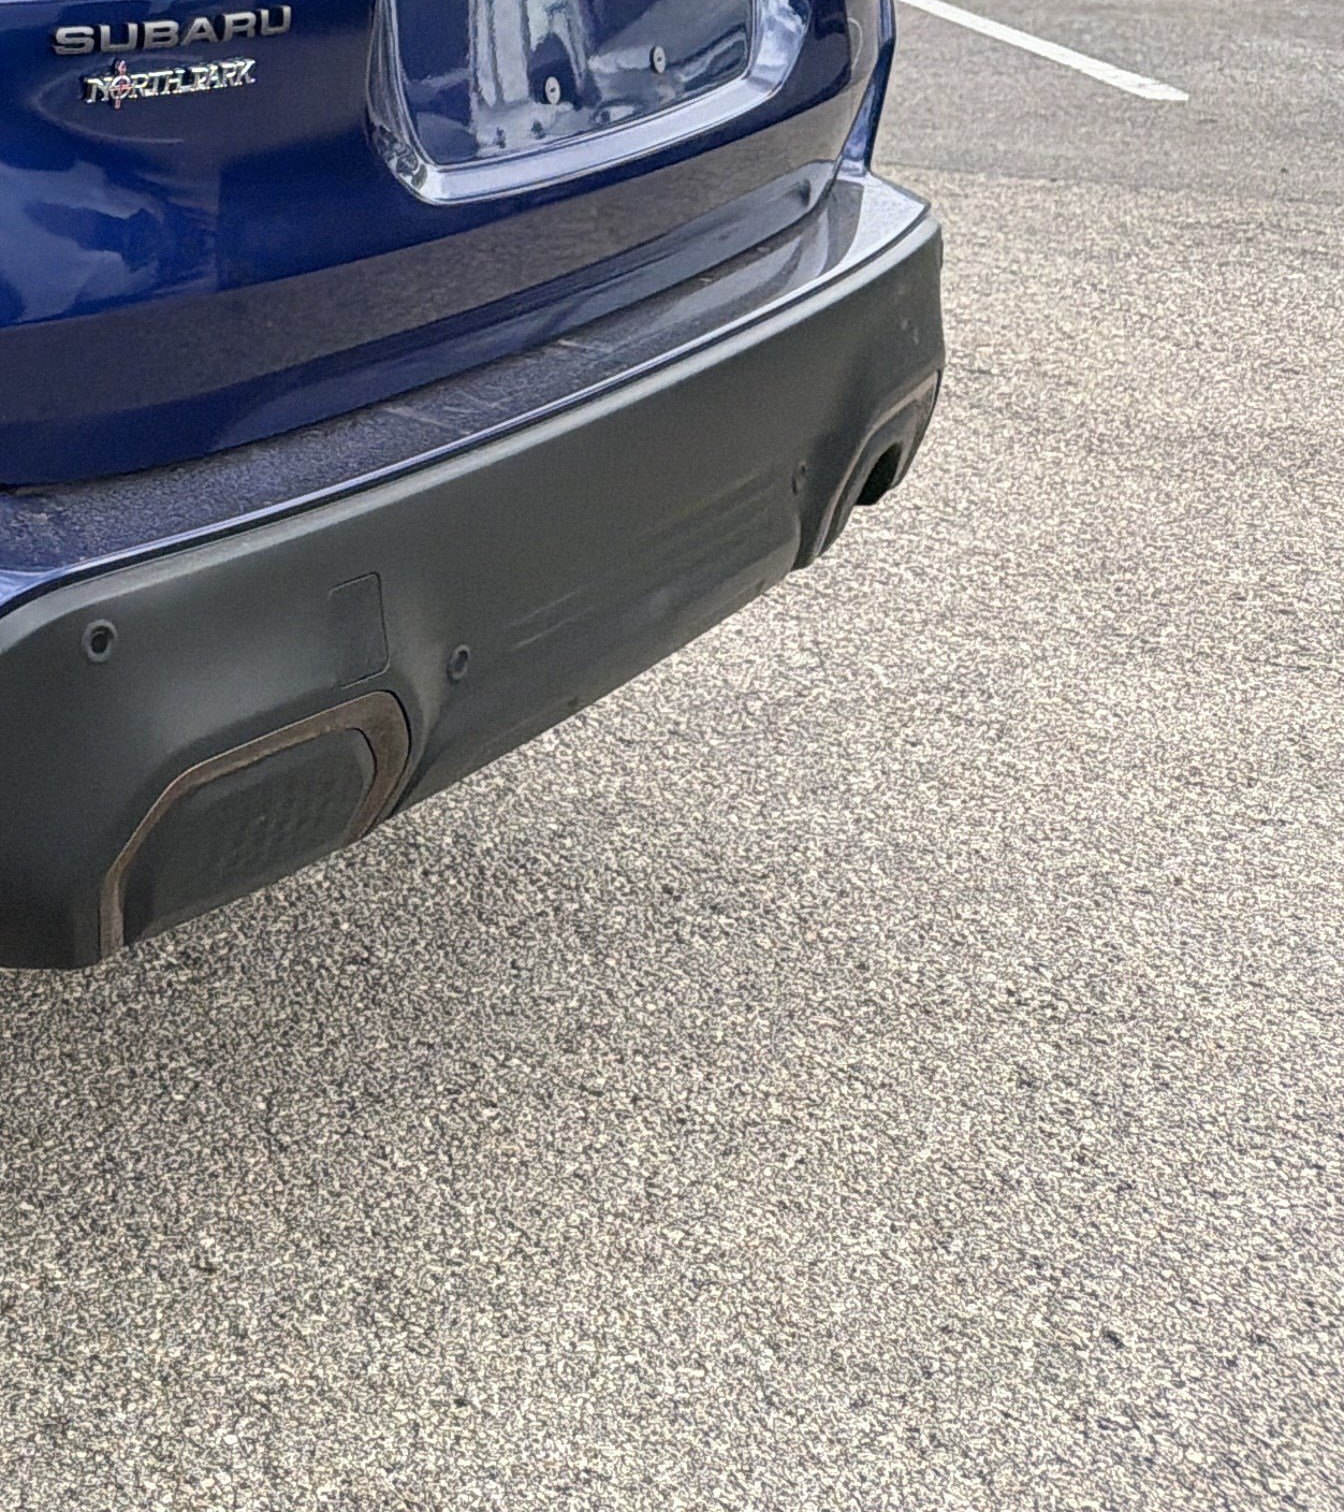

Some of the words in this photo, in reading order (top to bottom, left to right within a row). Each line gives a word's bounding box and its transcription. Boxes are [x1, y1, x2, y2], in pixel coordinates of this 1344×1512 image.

[53, 5, 291, 56] SUBARU
[85, 63, 185, 109] NORTH
[190, 59, 256, 91] PARK
